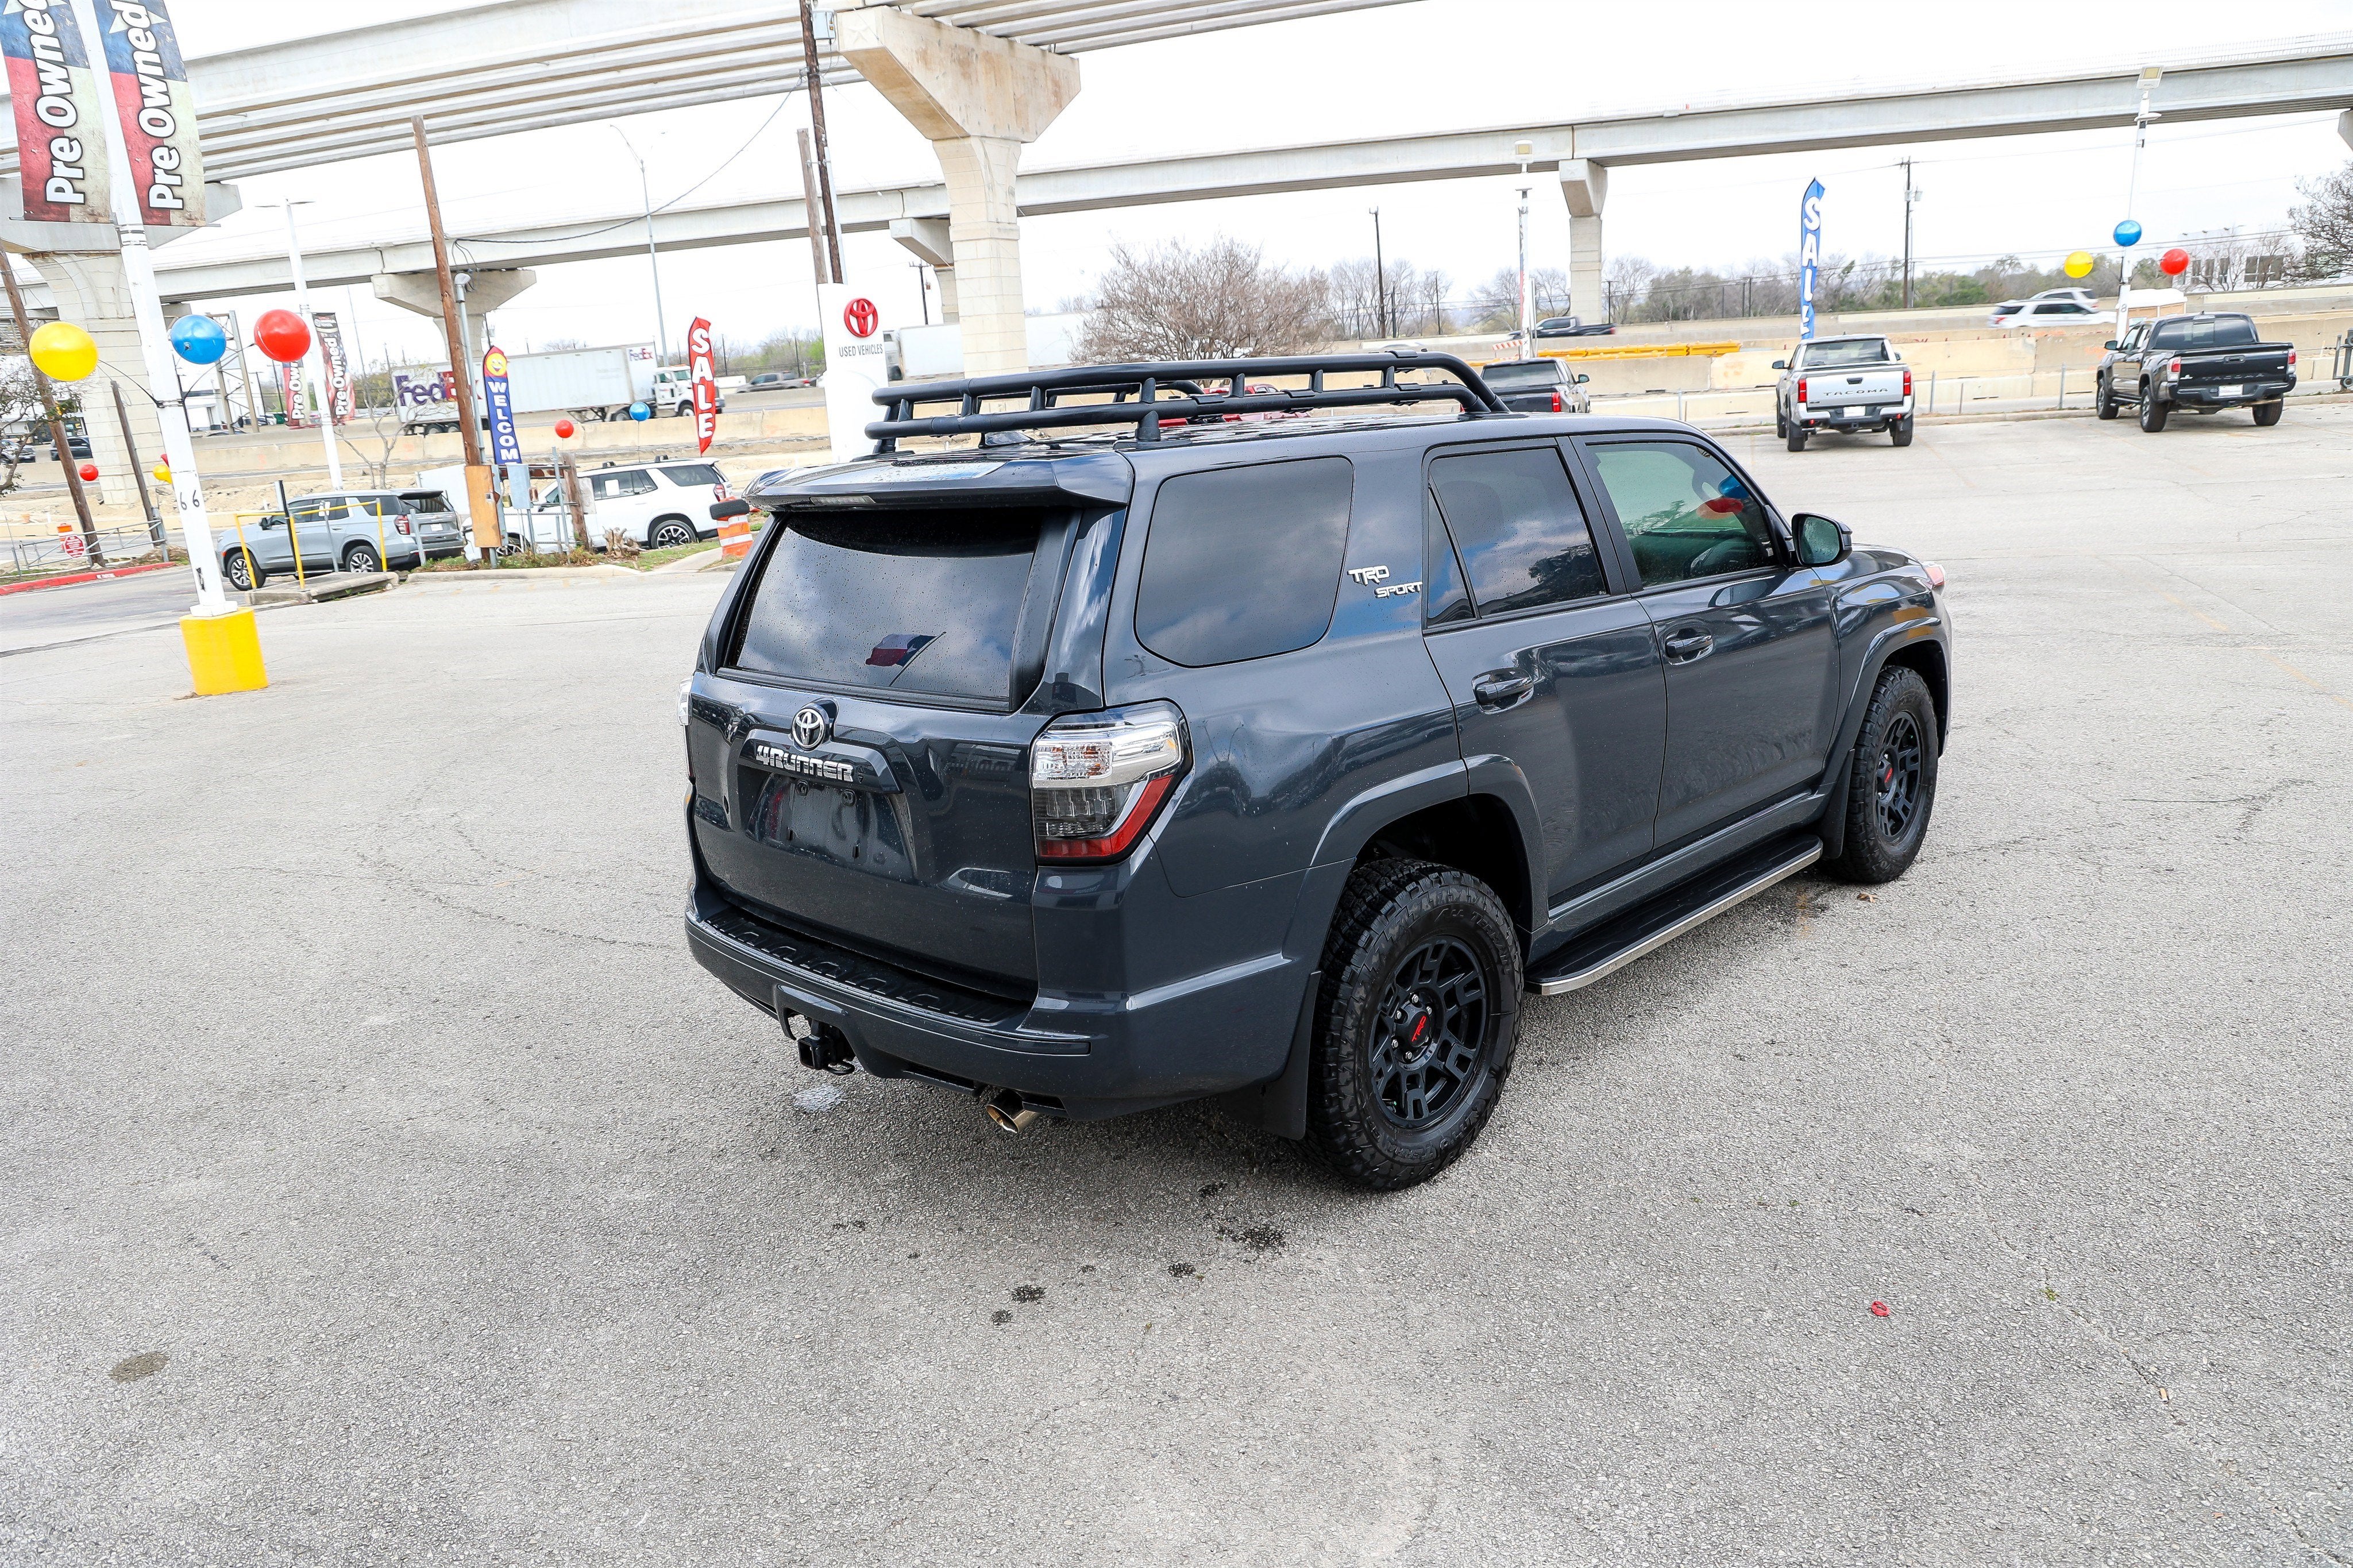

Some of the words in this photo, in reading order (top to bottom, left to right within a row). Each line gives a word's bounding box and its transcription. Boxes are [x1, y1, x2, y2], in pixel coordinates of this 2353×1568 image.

[46, 136, 86, 205] Pre
[149, 145, 184, 210] Pre
[839, 346, 857, 357] USED
[857, 343, 883, 356] VEHICLES
[691, 327, 713, 439] SALE
[1823, 388, 1888, 396] TACOMA
[291, 393, 305, 419] Pre
[488, 381, 519, 464] WELCOM
[1347, 565, 1390, 586] TRD
[1374, 581, 1423, 599] SPORT
[756, 745, 854, 782] 4RUNNER
[1411, 1015, 1426, 1042] TRD
